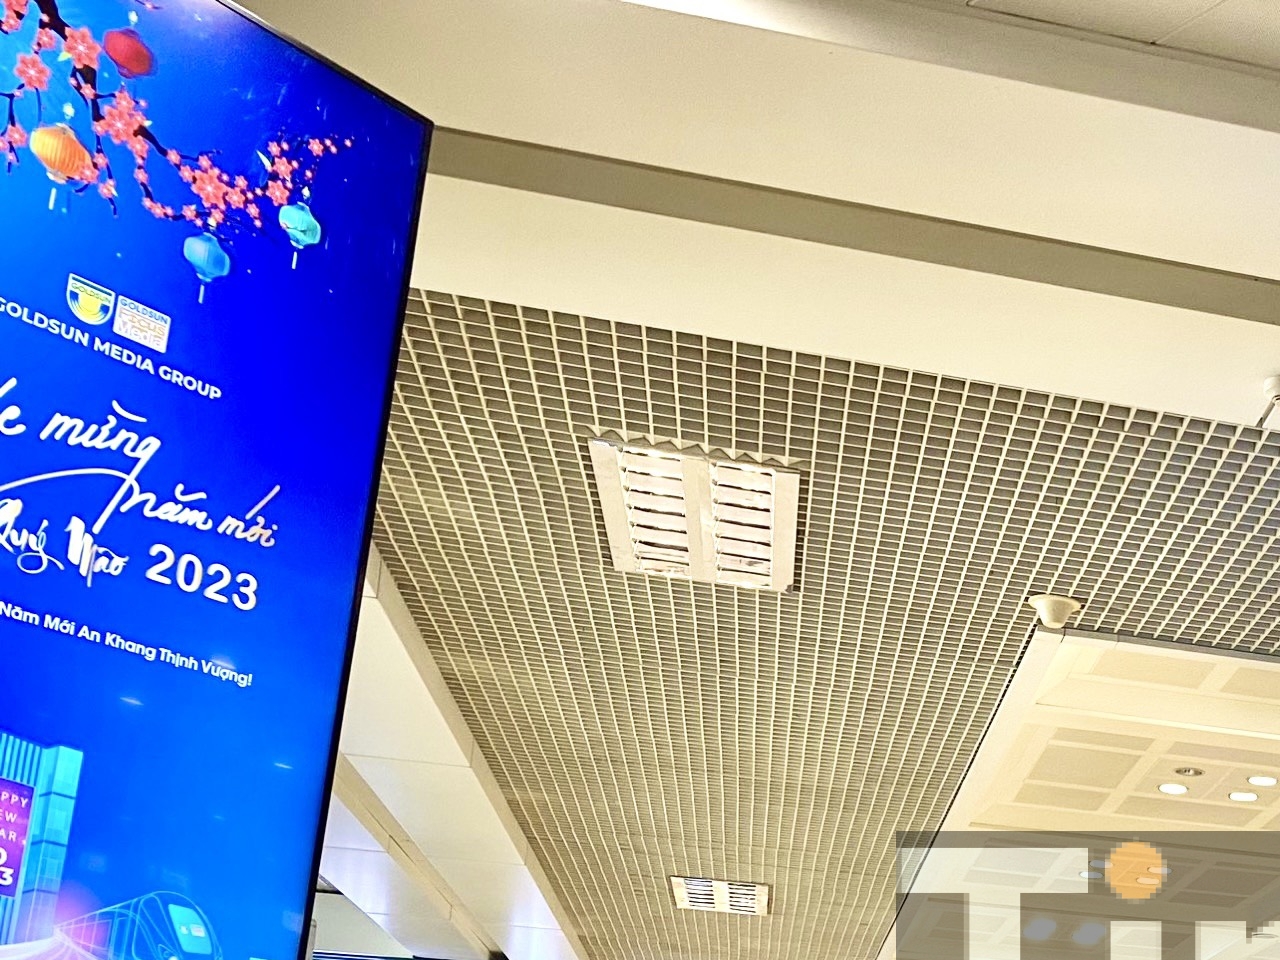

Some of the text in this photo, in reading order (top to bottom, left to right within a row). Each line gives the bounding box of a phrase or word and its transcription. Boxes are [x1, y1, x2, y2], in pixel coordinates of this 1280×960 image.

[119, 298, 168, 325] GOLDSUN
[93, 336, 155, 375] MEDIA
[158, 365, 222, 399] GROUP
[217, 484, 280, 547] mới
[145, 543, 258, 611] 2023
[0, 602, 253, 688] Năm Mới An Khang Thịnh Vượng!
